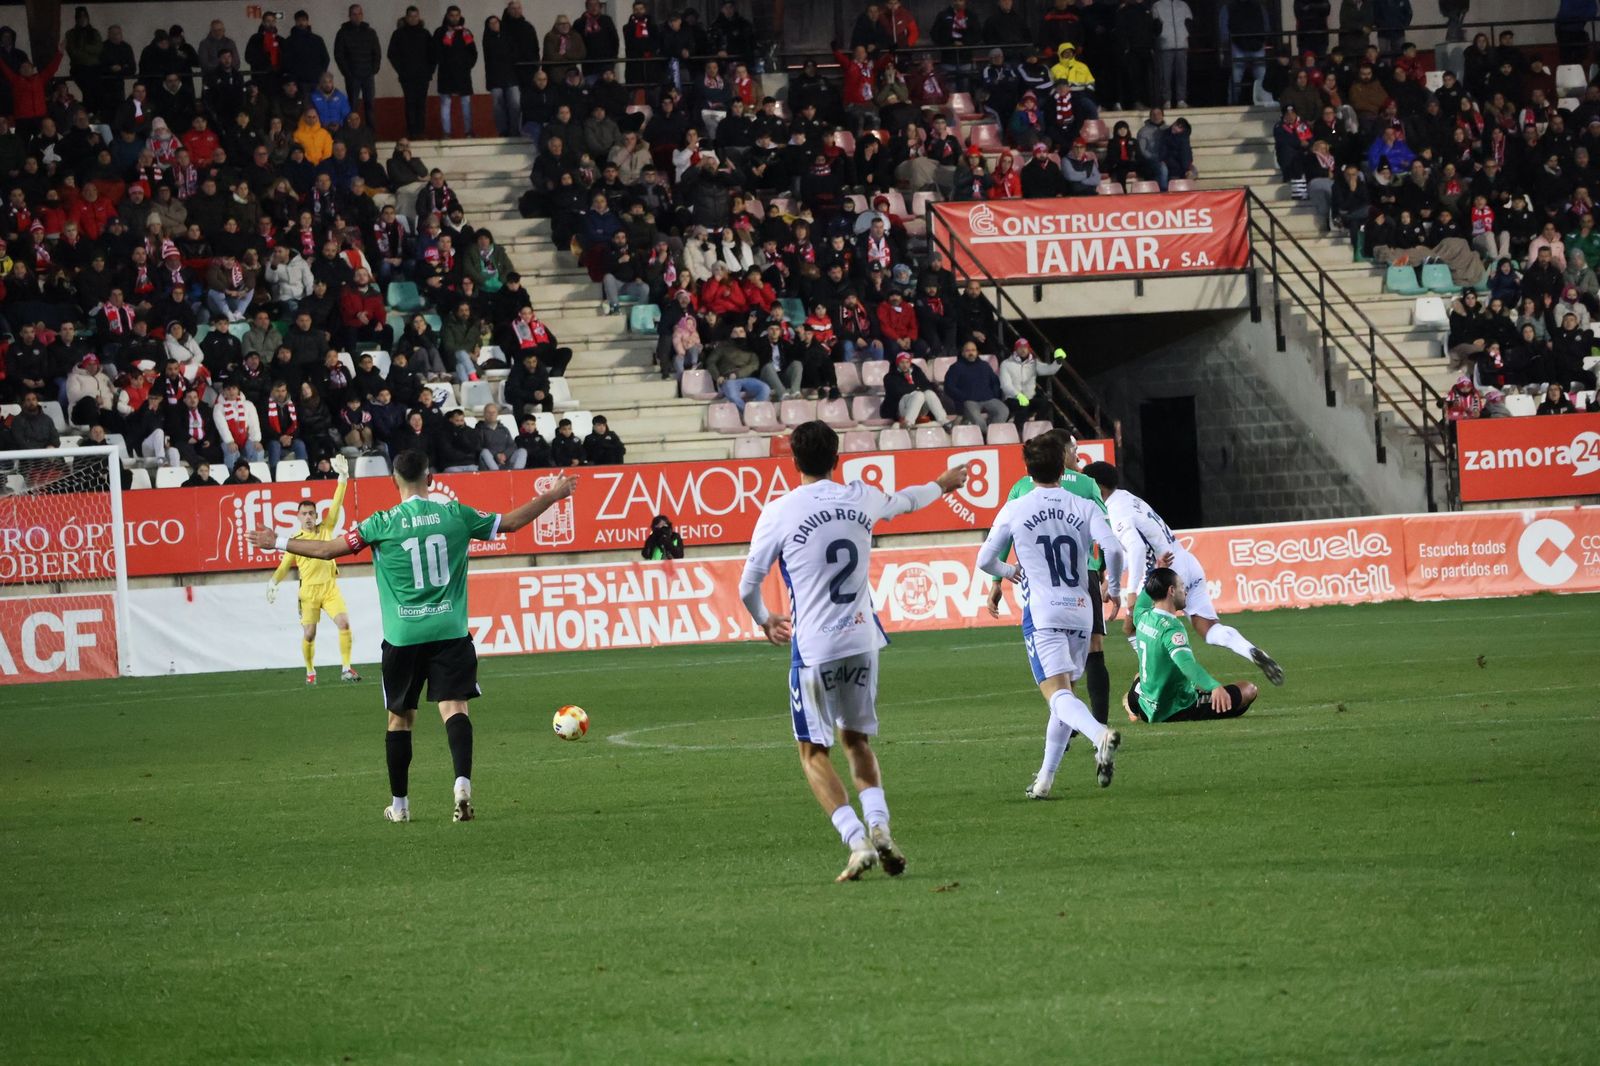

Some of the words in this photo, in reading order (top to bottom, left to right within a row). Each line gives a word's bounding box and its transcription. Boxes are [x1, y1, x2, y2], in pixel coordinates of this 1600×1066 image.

[1025, 236, 1170, 274] TAMAR,
[1181, 251, 1215, 267] S.A.
[593, 466, 791, 520] ZAMORA
[594, 523, 723, 543] AYUNTIENTO
[793, 510, 832, 545] DAVID
[1023, 508, 1065, 531] NACHO
[1066, 512, 1085, 532] GIL
[401, 533, 450, 590] 10
[1035, 535, 1080, 588] 10
[1228, 528, 1392, 566] Escuela
[1419, 541, 1470, 557] Escucha
[1471, 539, 1507, 555] todos
[825, 538, 859, 605] 2
[1236, 564, 1396, 604] infantil
[1420, 563, 1439, 579] los
[1441, 561, 1491, 581] partidos
[1493, 563, 1509, 576] en
[1139, 640, 1147, 683] 7
